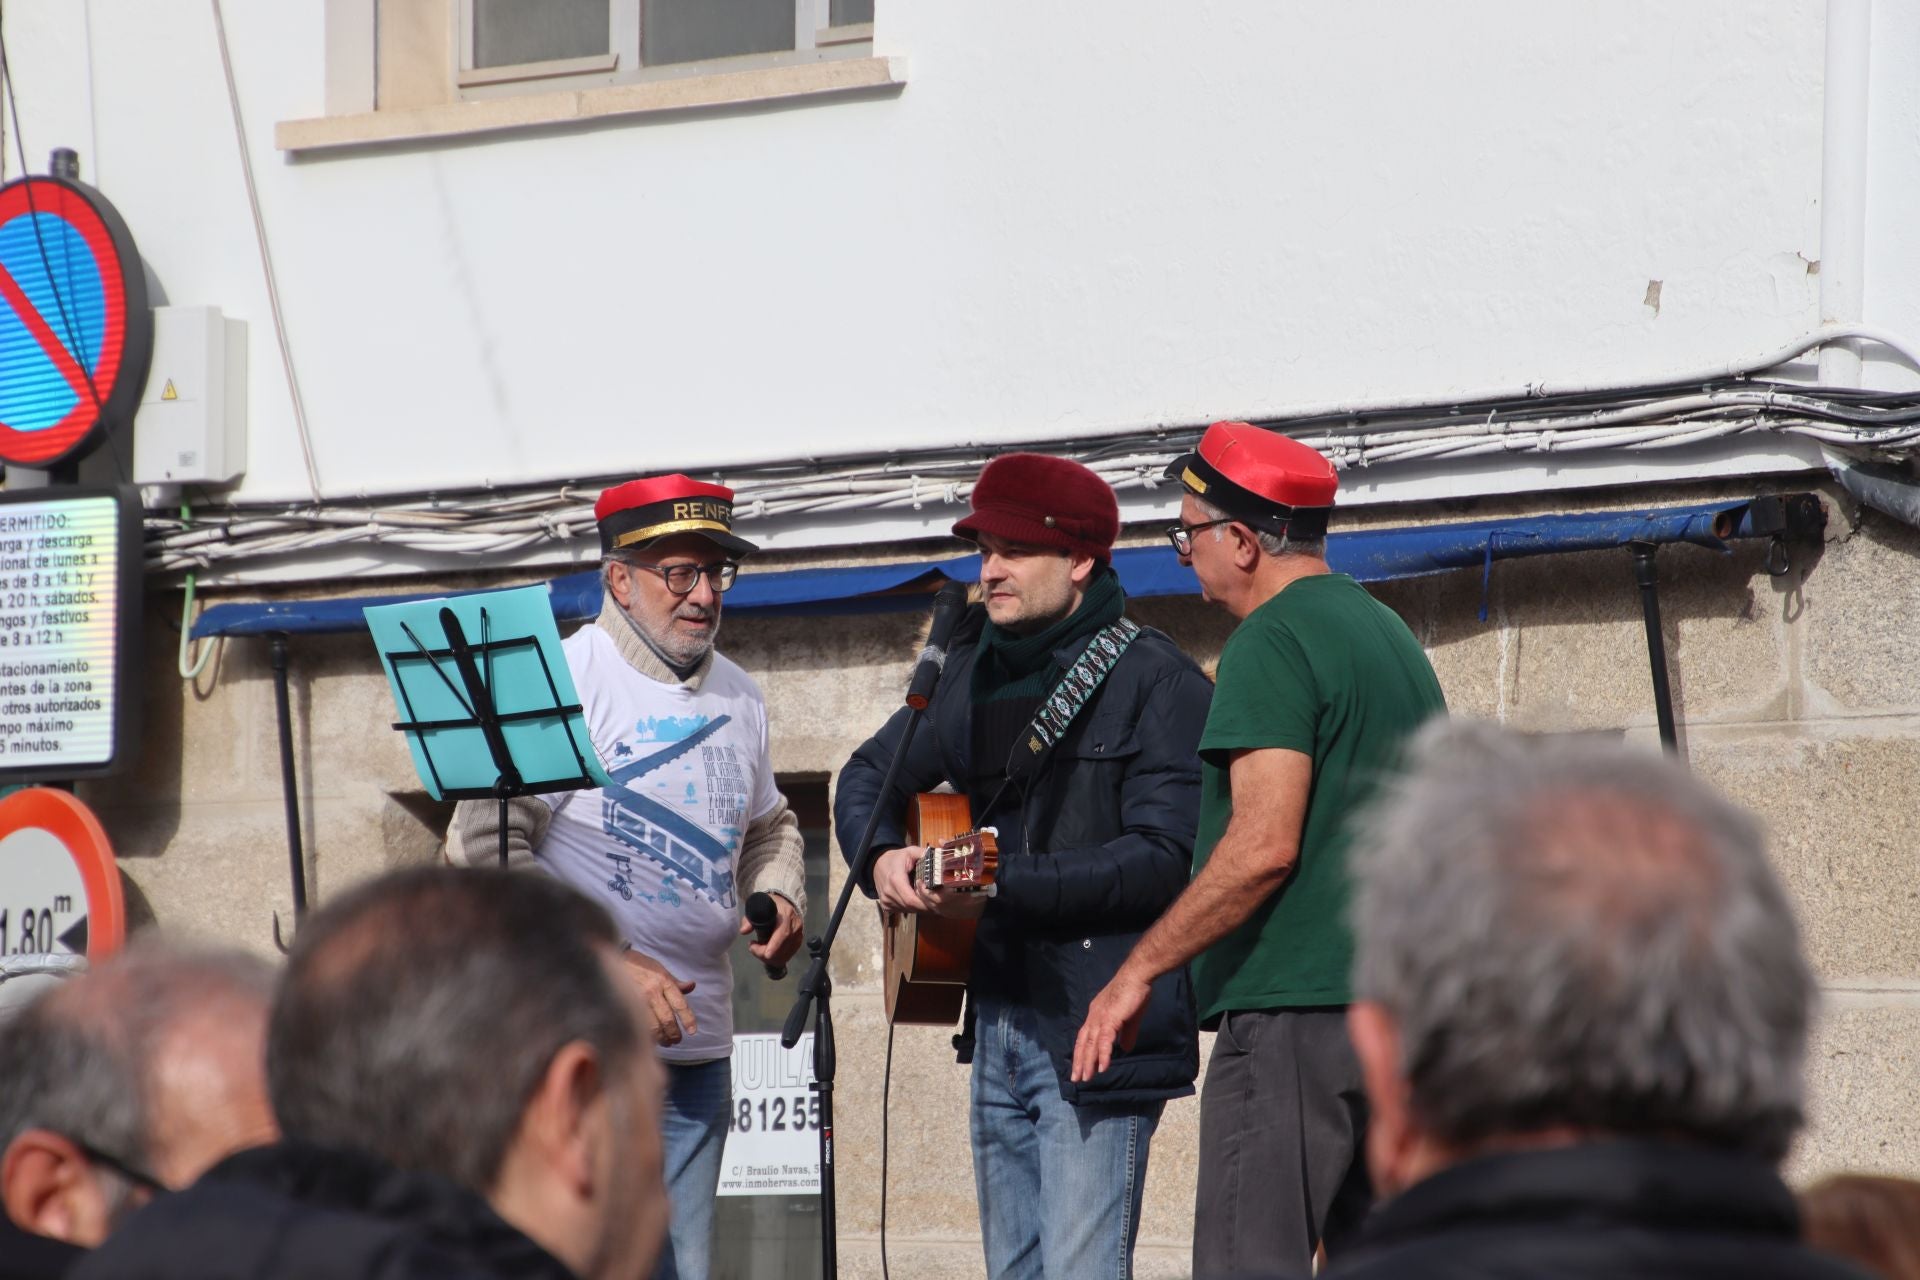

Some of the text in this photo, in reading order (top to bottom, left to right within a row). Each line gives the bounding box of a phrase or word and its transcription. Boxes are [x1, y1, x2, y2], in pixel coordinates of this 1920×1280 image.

[673, 502, 732, 523] RENFE
[27, 538, 33, 552] y
[37, 534, 93, 549] descarga
[35, 555, 49, 569] de
[53, 553, 86, 568] lunes
[91, 554, 97, 565] a
[13, 574, 27, 589] de
[32, 573, 39, 588] 8
[45, 575, 51, 586] a
[56, 571, 68, 585] 14
[75, 570, 82, 585] h
[87, 572, 94, 585] y
[8, 592, 25, 609] 20
[31, 615, 38, 629] y
[41, 610, 89, 625] festivos
[13, 631, 20, 646] 8
[25, 634, 32, 645] a
[37, 629, 51, 644] 12
[56, 630, 62, 643] h
[31, 680, 45, 695] de
[49, 679, 59, 693] la
[64, 680, 92, 693] zona
[2, 697, 101, 715] otros autorizados
[26, 717, 73, 733] máximo
[707, 778, 714, 793] EL
[708, 808, 716, 825] EL
[0, 895, 71, 956] 1.80 m
[747, 1164, 779, 1176] Braulio
[782, 1164, 811, 1176] Navas,
[722, 1178, 819, 1189] www.inmohervas.com
